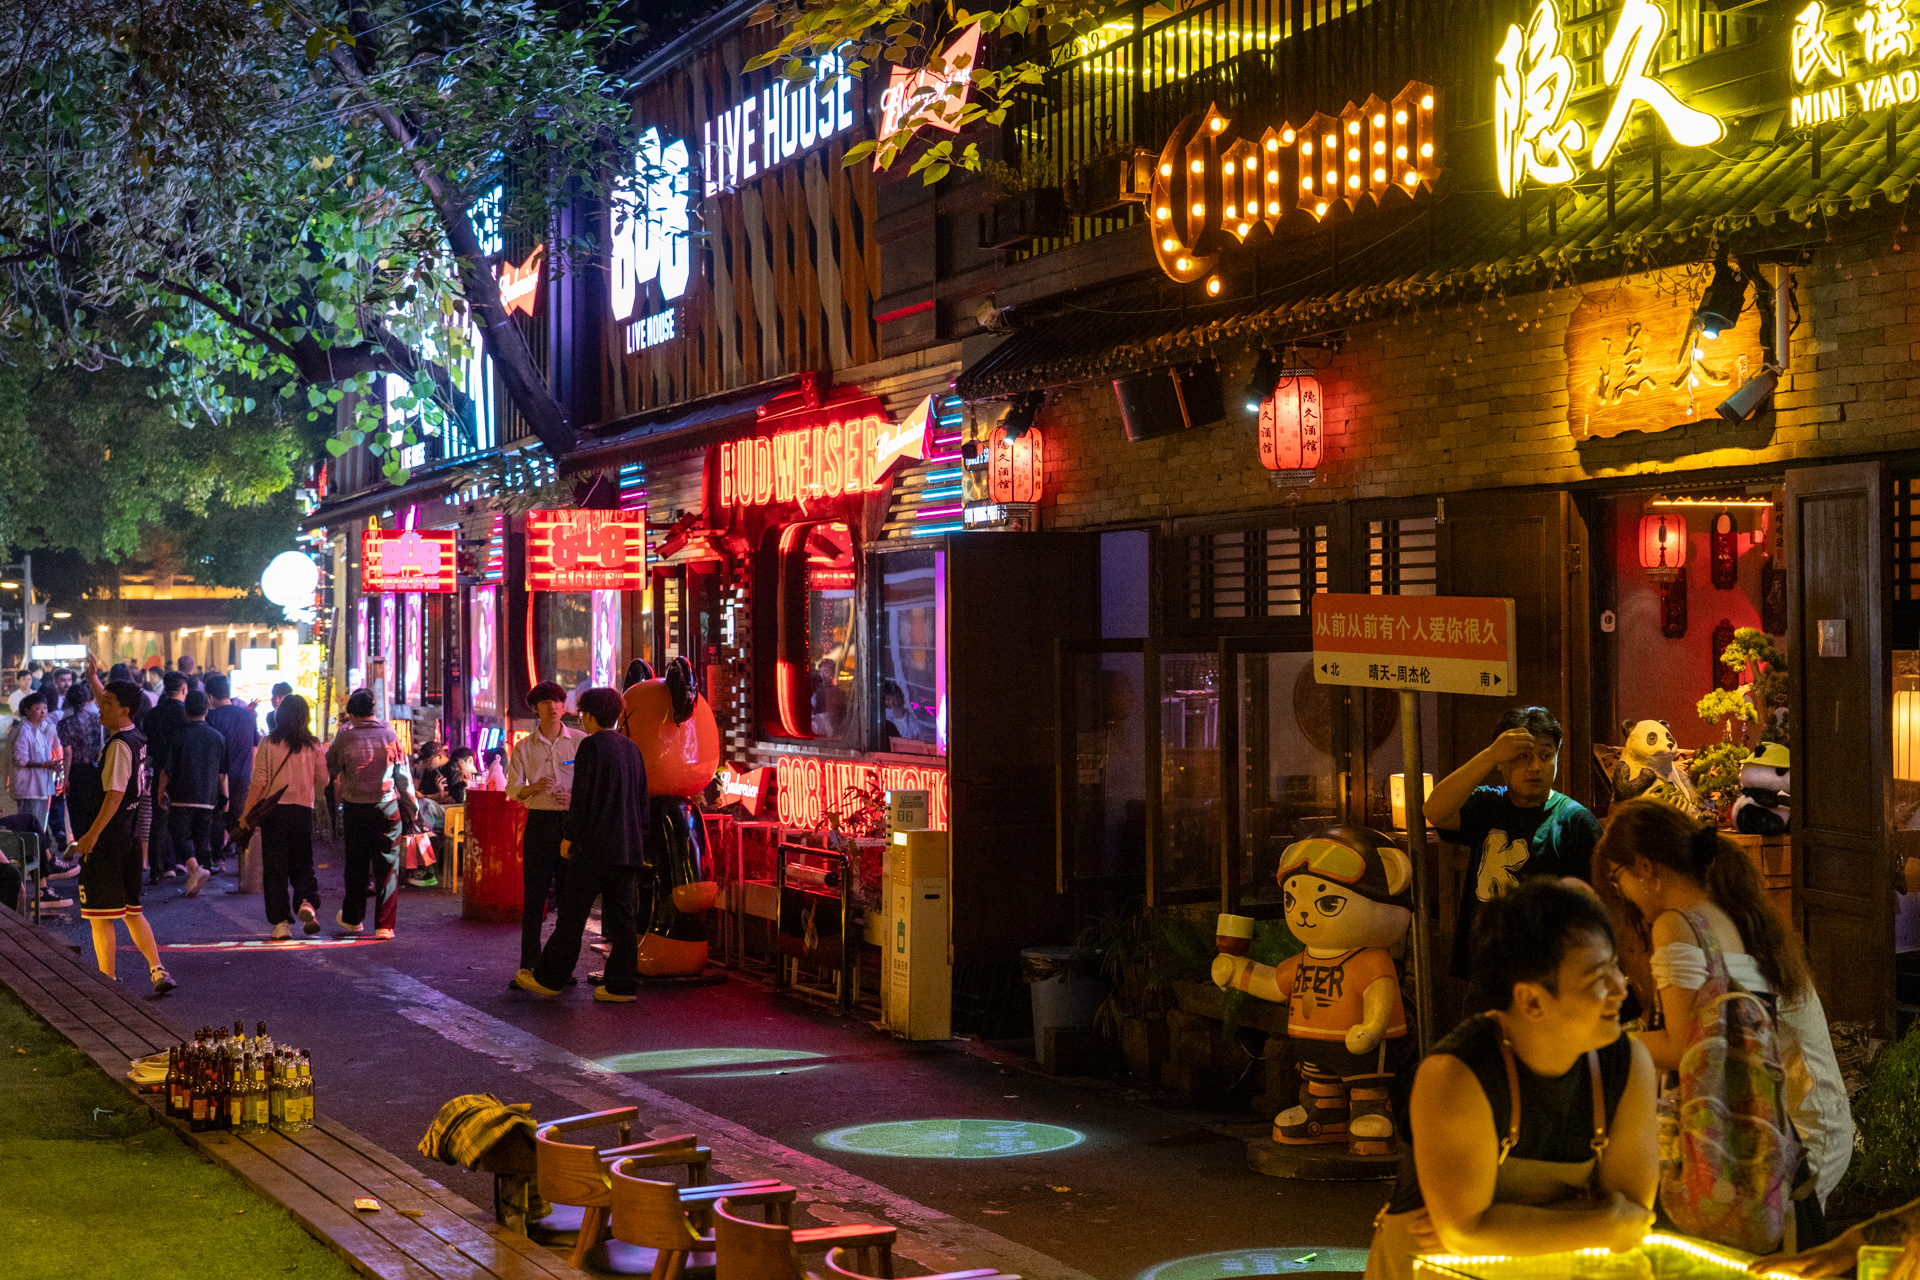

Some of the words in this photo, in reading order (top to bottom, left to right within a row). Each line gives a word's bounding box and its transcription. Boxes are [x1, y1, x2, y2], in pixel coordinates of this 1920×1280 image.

[1855, 70, 1917, 112] YAO
[704, 97, 757, 198] LIVE
[763, 40, 853, 169] HOUSE
[1151, 80, 1441, 297] Corona
[626, 318, 647, 354] LIVE
[647, 307, 675, 347] HOUSE
[1261, 401, 1273, 453] 久酒馆
[1304, 391, 1318, 451] 隐久酒馆
[720, 414, 884, 508] BUDWEISER
[382, 533, 441, 574] 808
[552, 523, 626, 567] 808
[1316, 612, 1498, 644] 从前从前有个人爱你很久
[1330, 662, 1340, 676] 北
[1368, 664, 1430, 684] 晴天-周杰伦
[1480, 671, 1490, 686] 南
[720, 770, 759, 798] Budweiser
[776, 754, 821, 830] 808
[1293, 964, 1344, 998] BEER
